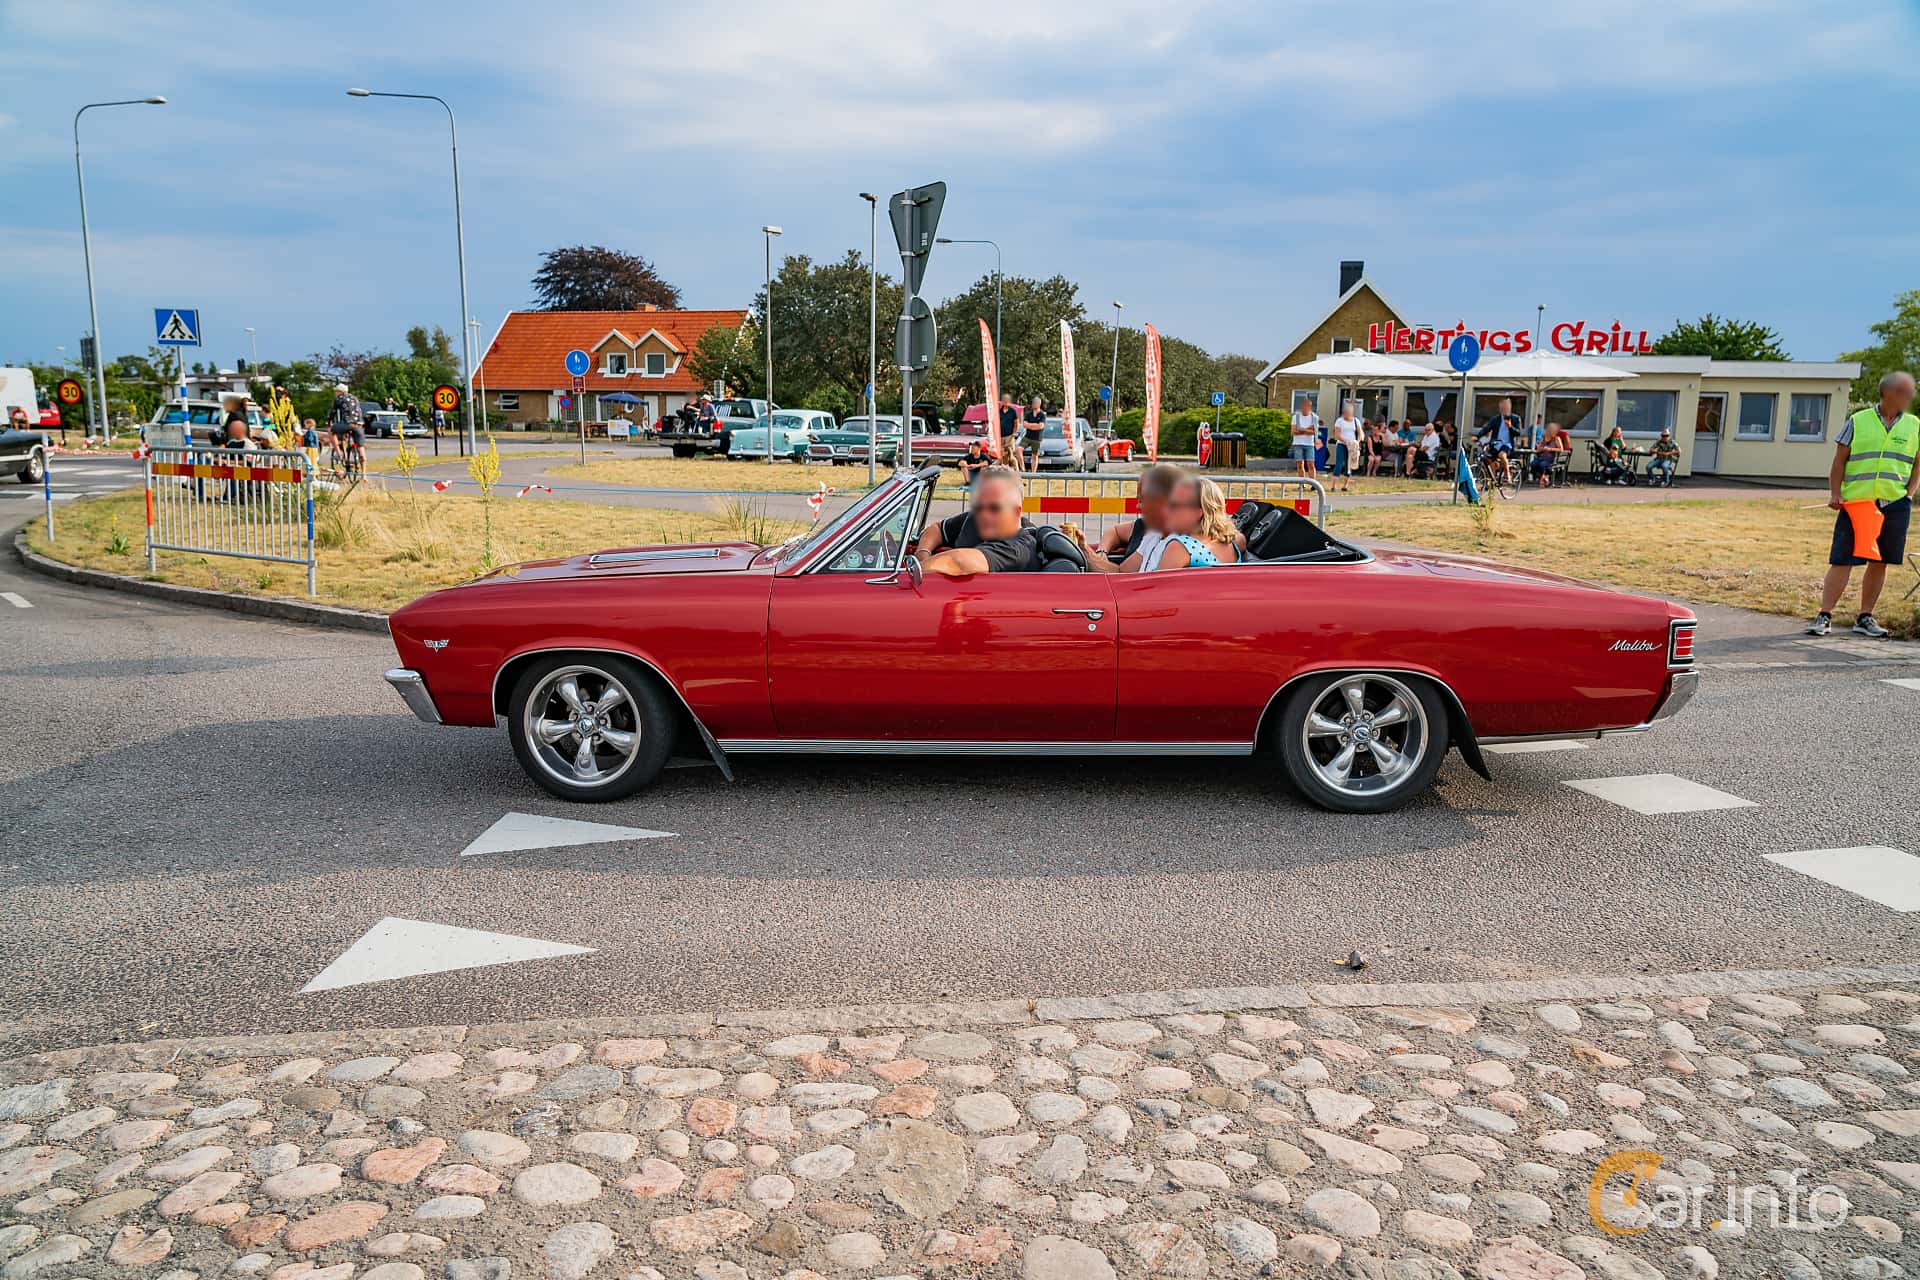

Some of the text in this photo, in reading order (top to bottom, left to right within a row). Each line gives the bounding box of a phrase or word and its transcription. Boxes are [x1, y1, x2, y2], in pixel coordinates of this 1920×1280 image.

[63, 386, 78, 399] 30
[439, 392, 455, 405] 30
[1607, 639, 1663, 652] Malibu
